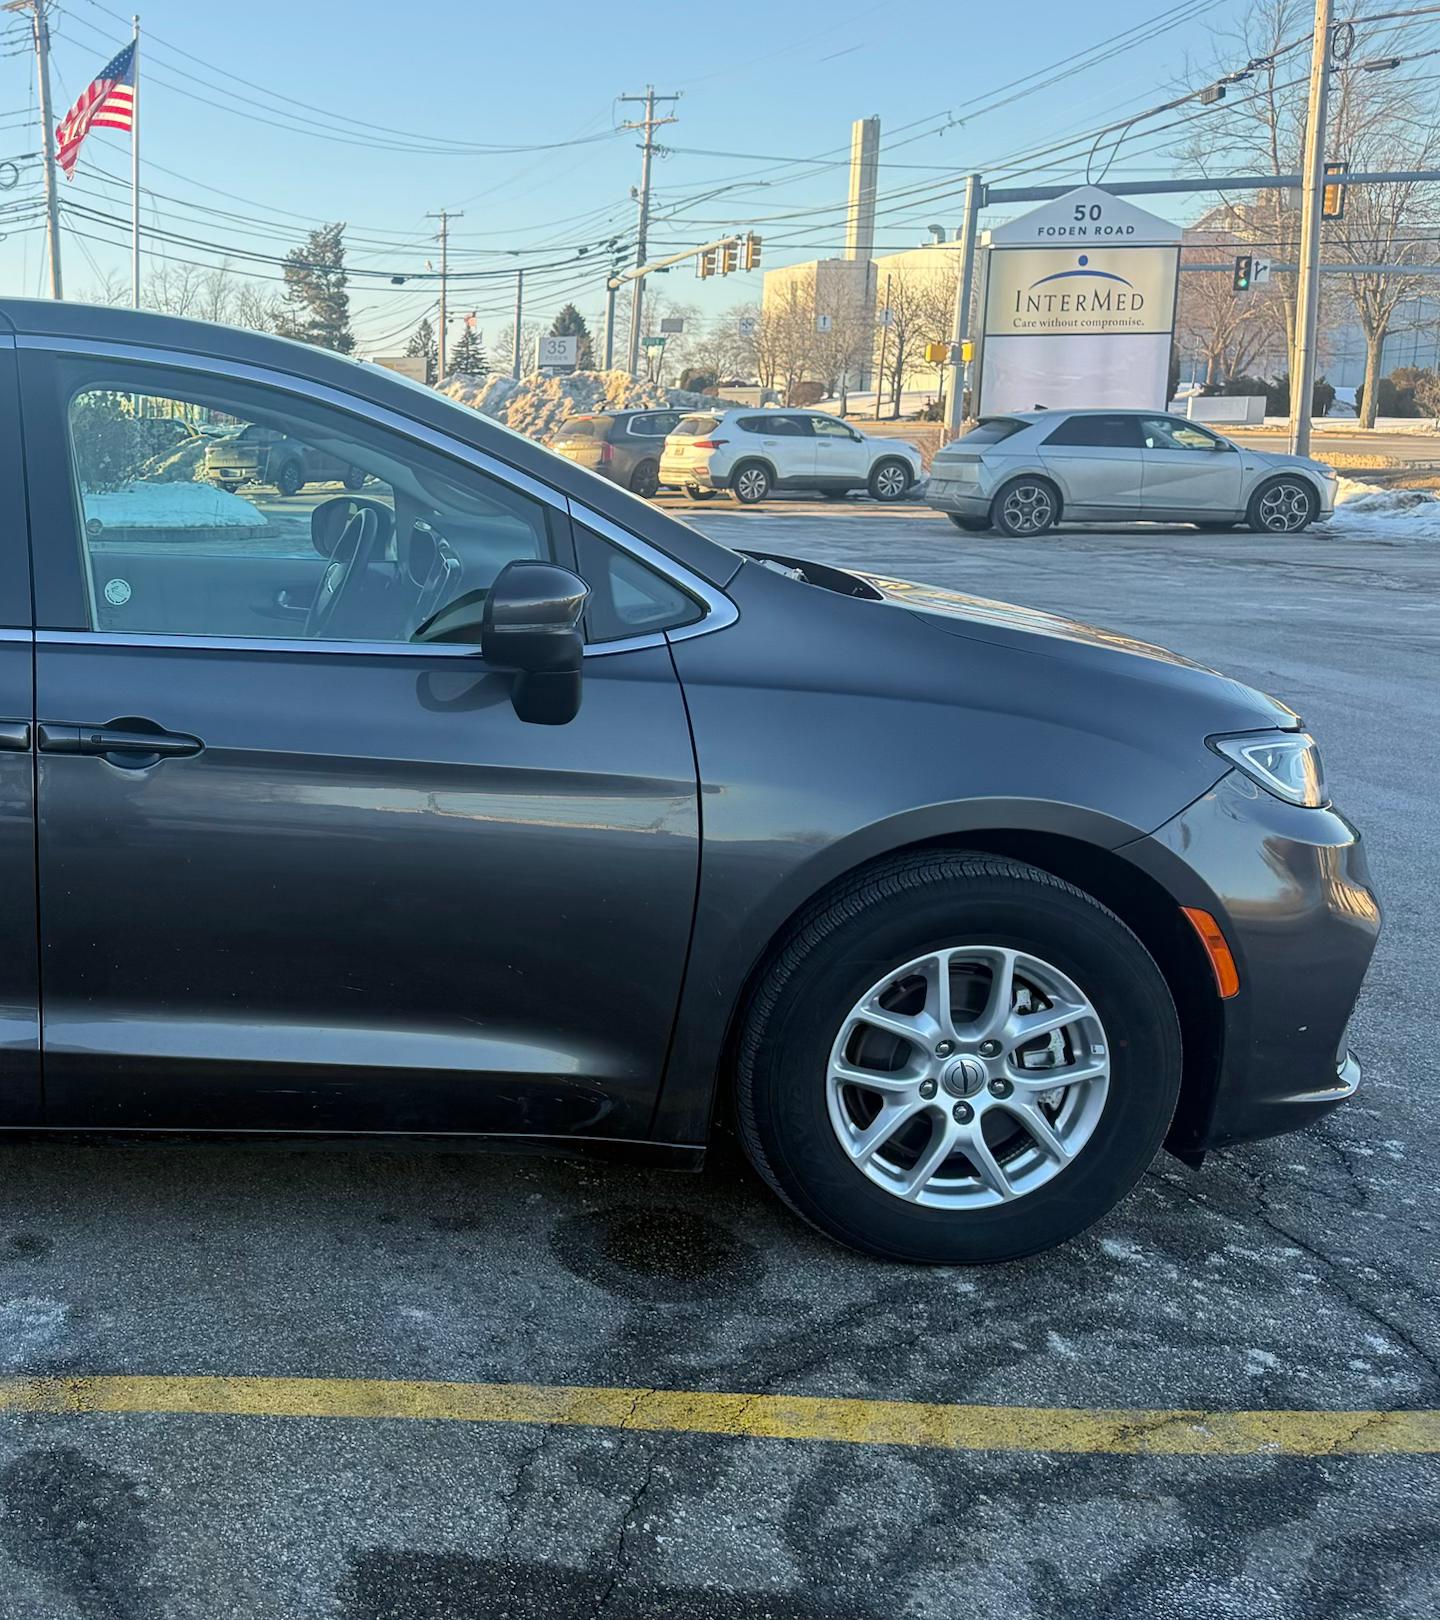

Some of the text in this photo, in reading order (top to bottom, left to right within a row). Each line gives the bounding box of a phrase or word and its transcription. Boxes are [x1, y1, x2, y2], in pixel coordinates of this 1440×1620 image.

[1073, 204, 1102, 221] 50
[1037, 225, 1135, 236] FODEN ROAD
[1013, 317, 1145, 329] Care without compromise.
[547, 340, 566, 354] 35
